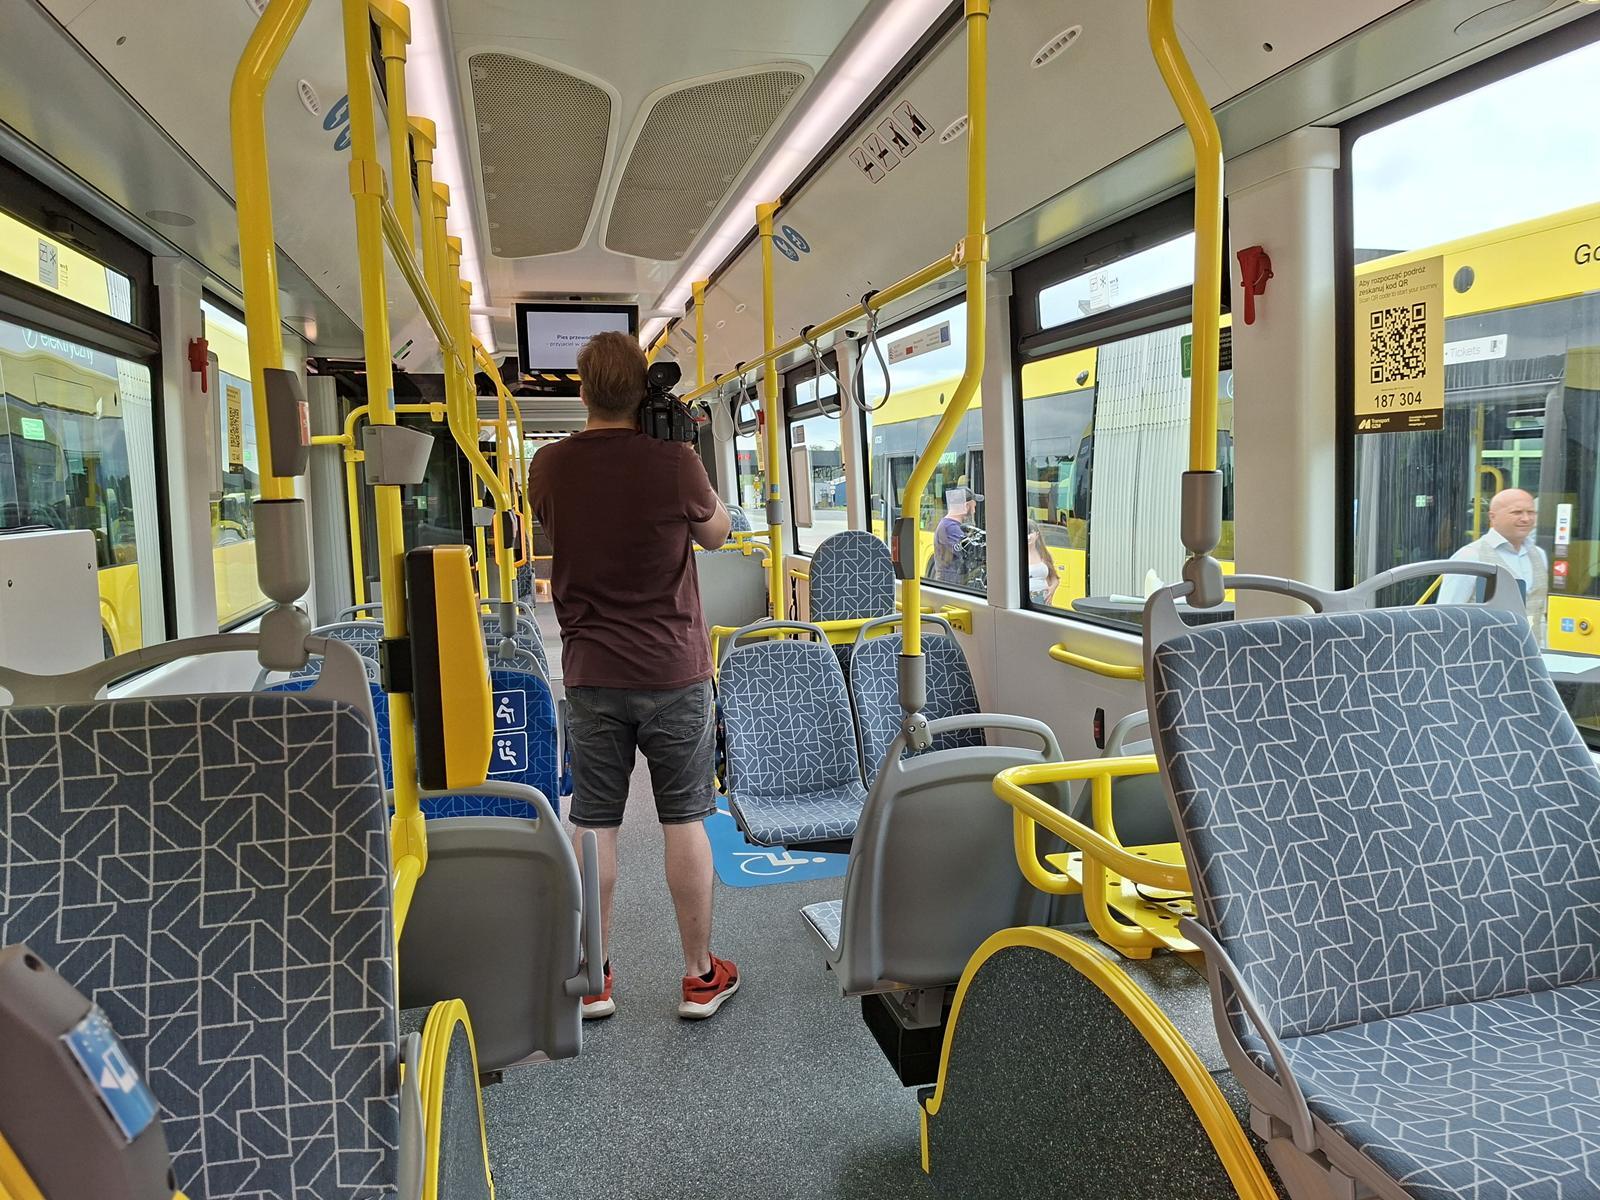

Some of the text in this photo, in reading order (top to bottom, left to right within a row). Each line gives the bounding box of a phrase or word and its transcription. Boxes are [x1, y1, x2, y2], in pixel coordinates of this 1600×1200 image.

[1359, 280, 1370, 288] Aby
[1403, 266, 1426, 279] podróż
[1359, 279, 1409, 296] zeskanuj kod QR
[1450, 346, 1480, 358] Tickets
[1374, 391, 1422, 408] 187 304
